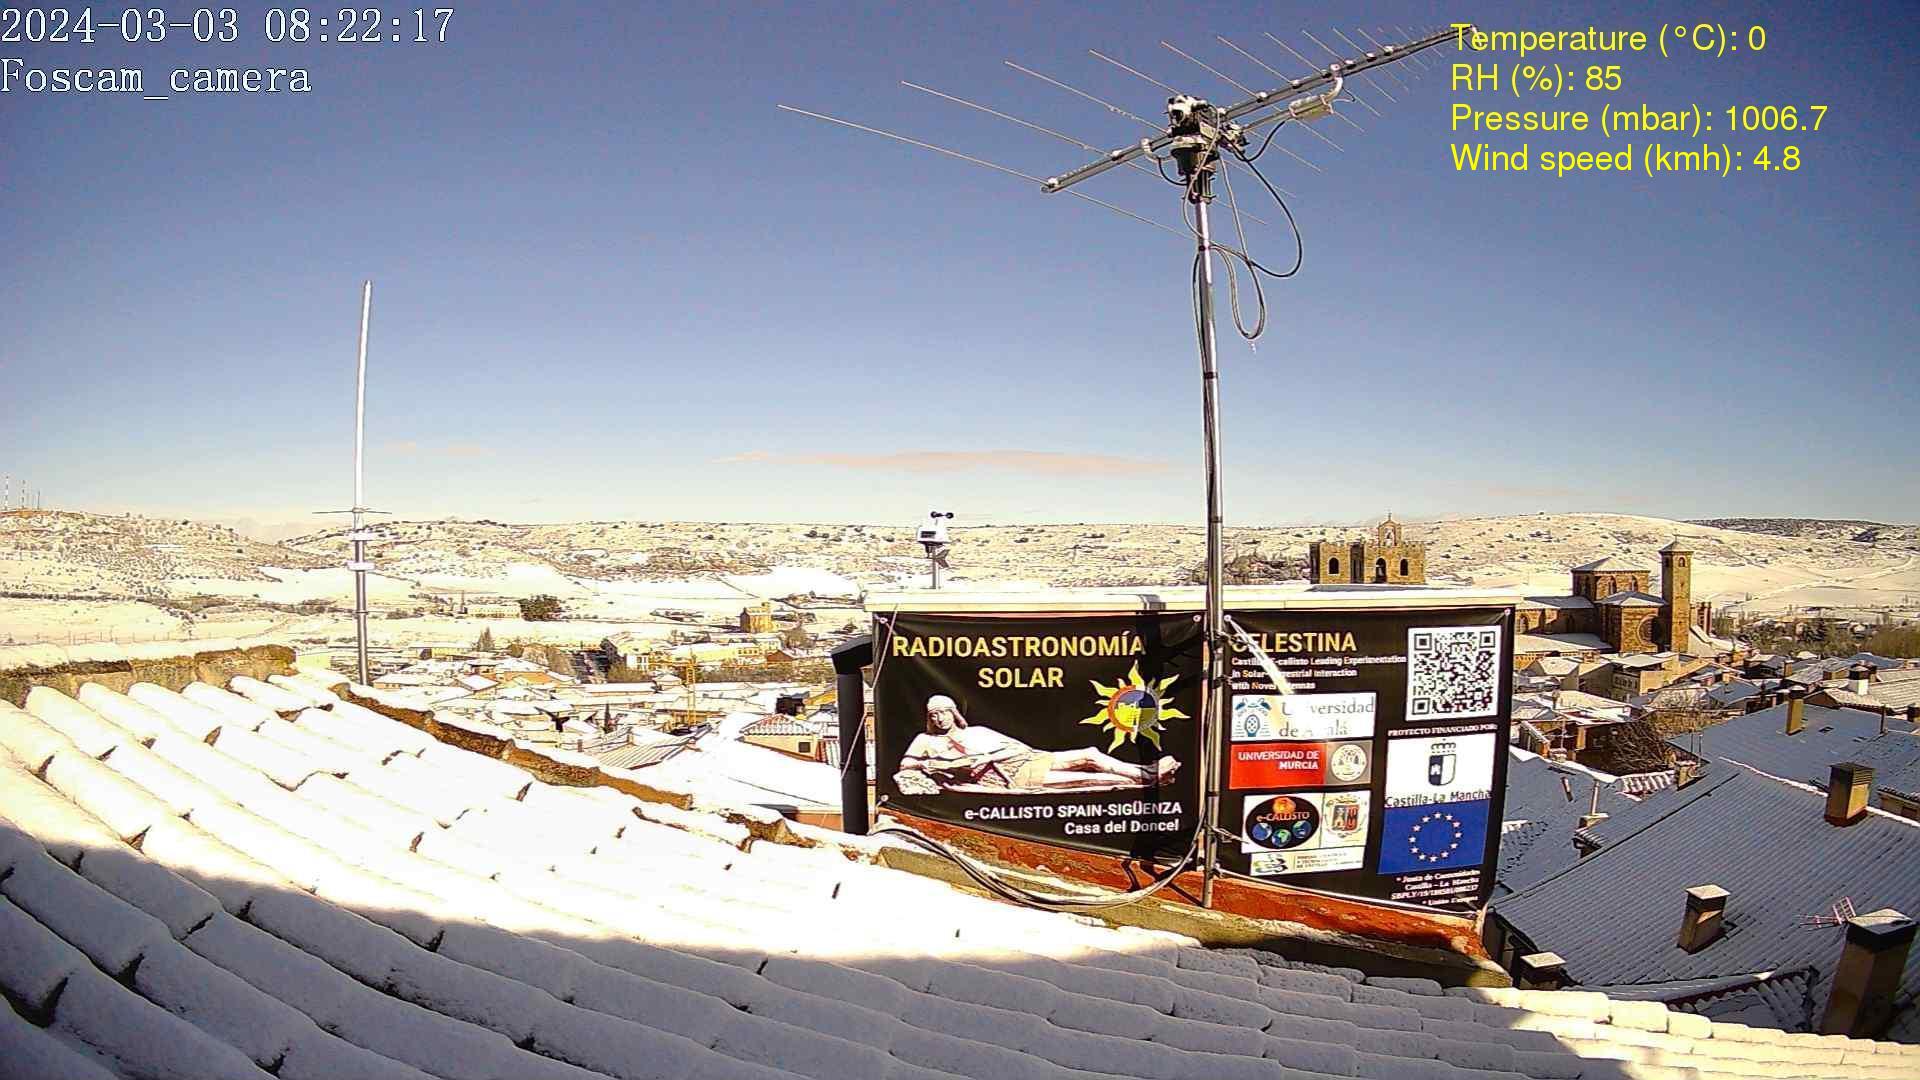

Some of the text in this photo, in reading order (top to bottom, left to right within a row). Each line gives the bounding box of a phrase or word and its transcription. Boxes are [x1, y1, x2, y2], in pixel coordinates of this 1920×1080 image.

[892, 630, 1146, 658] RADIOASTRONOMÍA
[977, 667, 1064, 688] SOLAR
[1281, 696, 1375, 716] Uversidad
[1279, 721, 1299, 737] de
[1238, 750, 1320, 761] UNIVERSIDAD DE
[1279, 761, 1319, 770] MURCIA
[1385, 794, 1446, 807] Castilla-La
[964, 800, 1182, 820] e-CALLISTO SPAIN-SIGÜENZA
[1256, 811, 1310, 822] e-CALLISTO
[1064, 818, 1180, 835] Casa del Doncel
